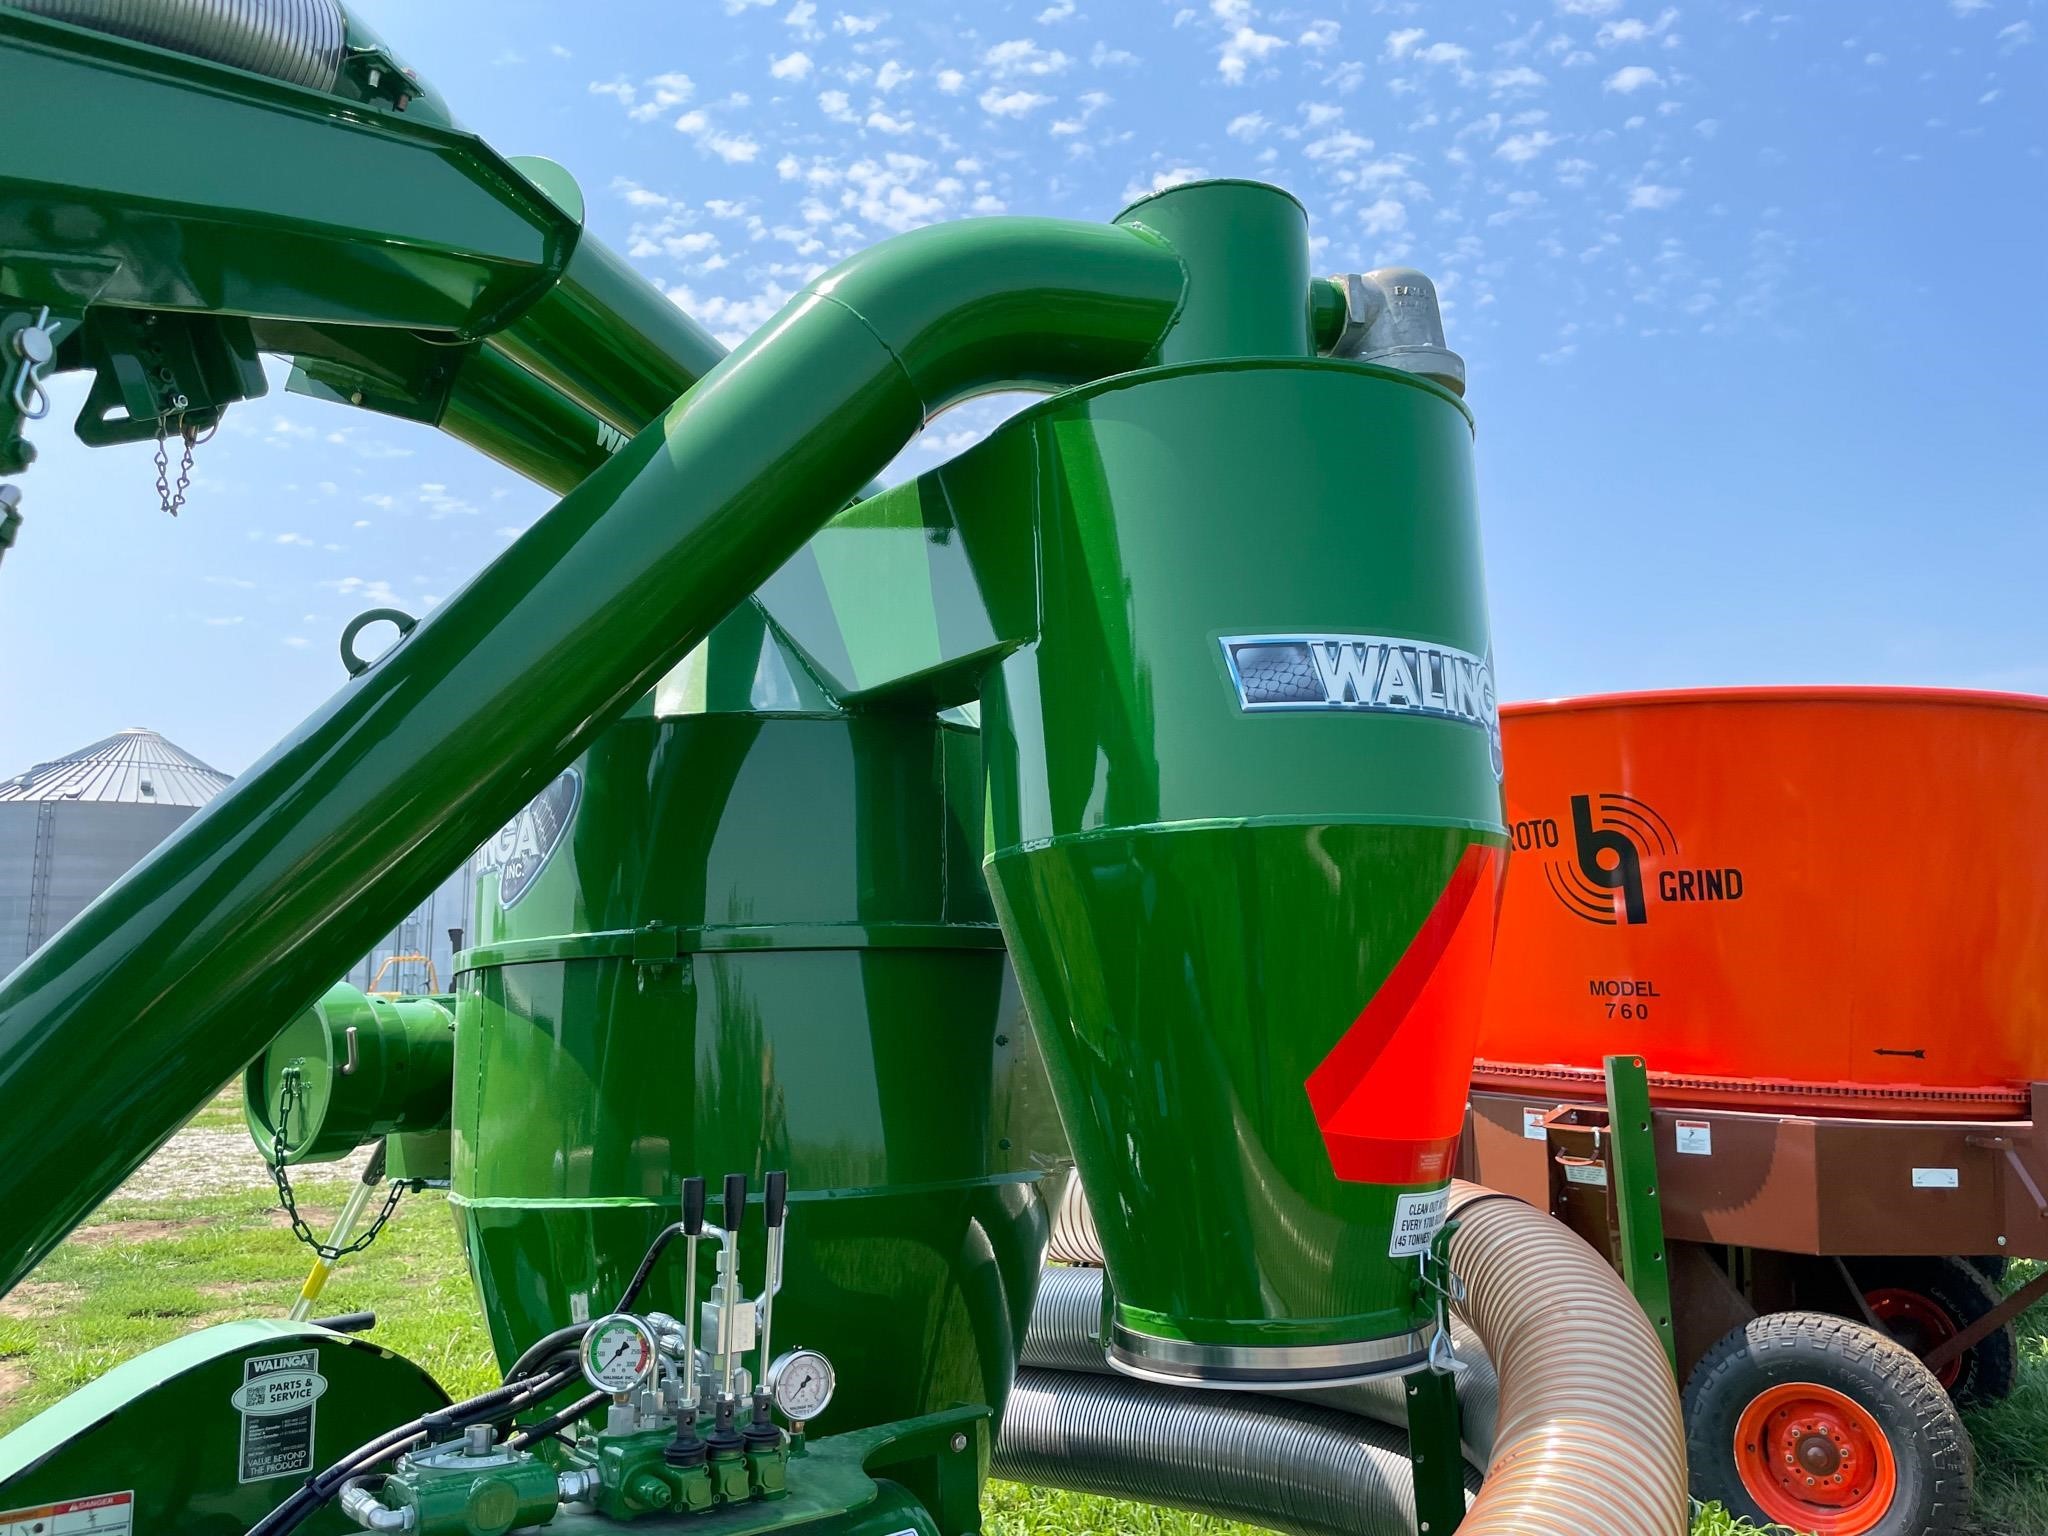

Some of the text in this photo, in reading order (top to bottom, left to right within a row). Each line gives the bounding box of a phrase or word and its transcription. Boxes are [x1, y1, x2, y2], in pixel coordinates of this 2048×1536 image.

[505, 863, 525, 880] INC.
[1658, 868, 1743, 901] GRIND
[1589, 980, 1661, 997] MODEL
[1605, 1003, 1649, 1020] 760
[1409, 1204, 1428, 1216] CLEAN
[1401, 1219, 1422, 1231] EVERY
[254, 1354, 309, 1373] WALINGA
[269, 1378, 313, 1393] PARTS &
[270, 1388, 312, 1403] SERVICE
[247, 1455, 272, 1467] VALUE
[273, 1450, 307, 1463] BEYOND
[250, 1458, 303, 1476] THE PRODUCT
